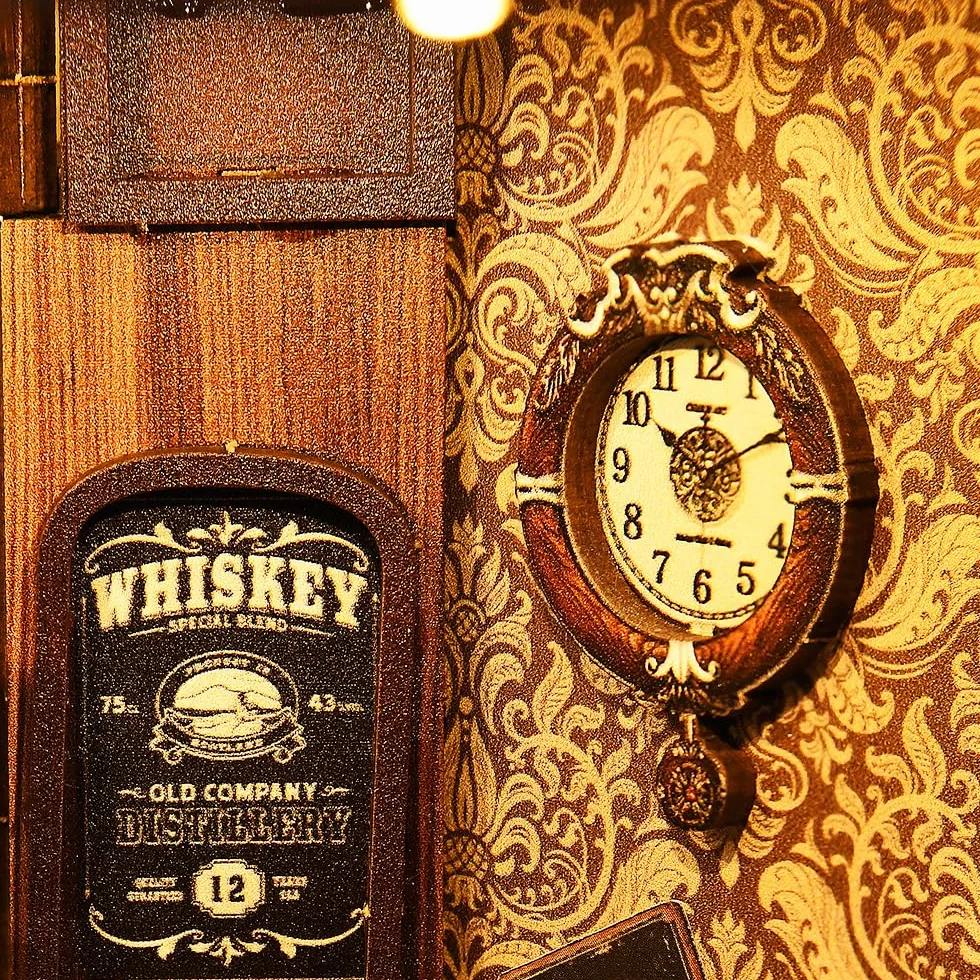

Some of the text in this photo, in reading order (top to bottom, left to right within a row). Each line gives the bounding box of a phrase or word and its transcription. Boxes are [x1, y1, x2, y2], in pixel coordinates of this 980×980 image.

[652, 355, 678, 392] 11
[695, 344, 725, 381] 12
[622, 390, 650, 427] 10
[613, 448, 630, 483] 9
[624, 503, 642, 540] 8
[768, 523, 787, 559] 4
[652, 550, 670, 584] 7
[736, 561, 755, 596] 5
[91, 553, 368, 631] WHISKEY
[693, 569, 712, 604] 6
[168, 613, 288, 633] SPECIAL BLEND
[149, 782, 317, 802] OLD COMPANY
[116, 806, 352, 846] DISTILLERY
[211, 874, 245, 902] 12
